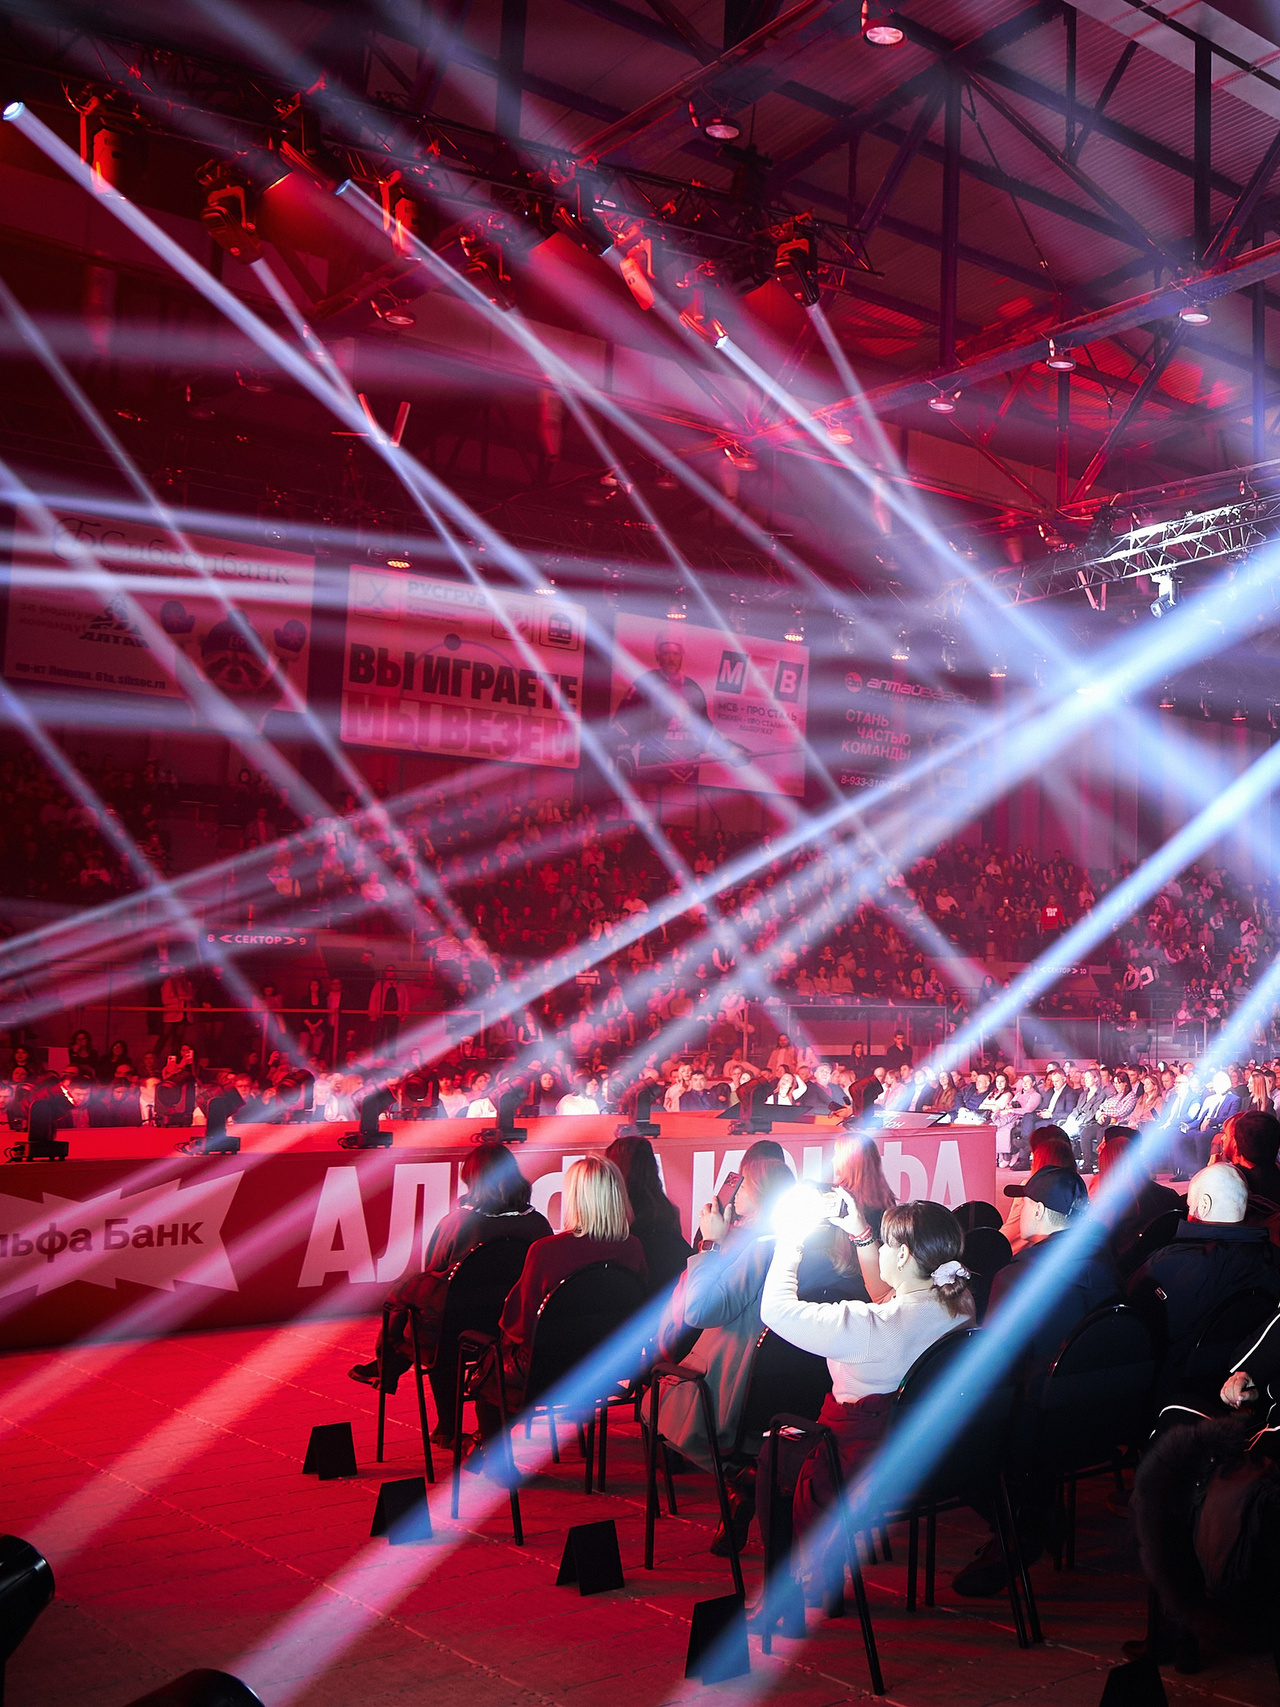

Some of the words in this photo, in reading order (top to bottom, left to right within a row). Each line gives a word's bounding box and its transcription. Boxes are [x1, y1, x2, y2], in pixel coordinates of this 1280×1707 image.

[408, 581, 486, 606] РУСГРУЗ
[348, 643, 416, 690] ВЫ
[422, 653, 578, 712] ИГРАЕТЕ
[347, 692, 430, 748] МЫ
[846, 709, 889, 727] СТАНЬ
[857, 725, 911, 746] ЧАСТЬЮ
[841, 740, 911, 762] КОМАНДЫ
[207, 933, 215, 944] 8
[234, 934, 282, 945] СЕКТОР
[299, 937, 307, 946] 9
[104, 1218, 204, 1250] Банк
